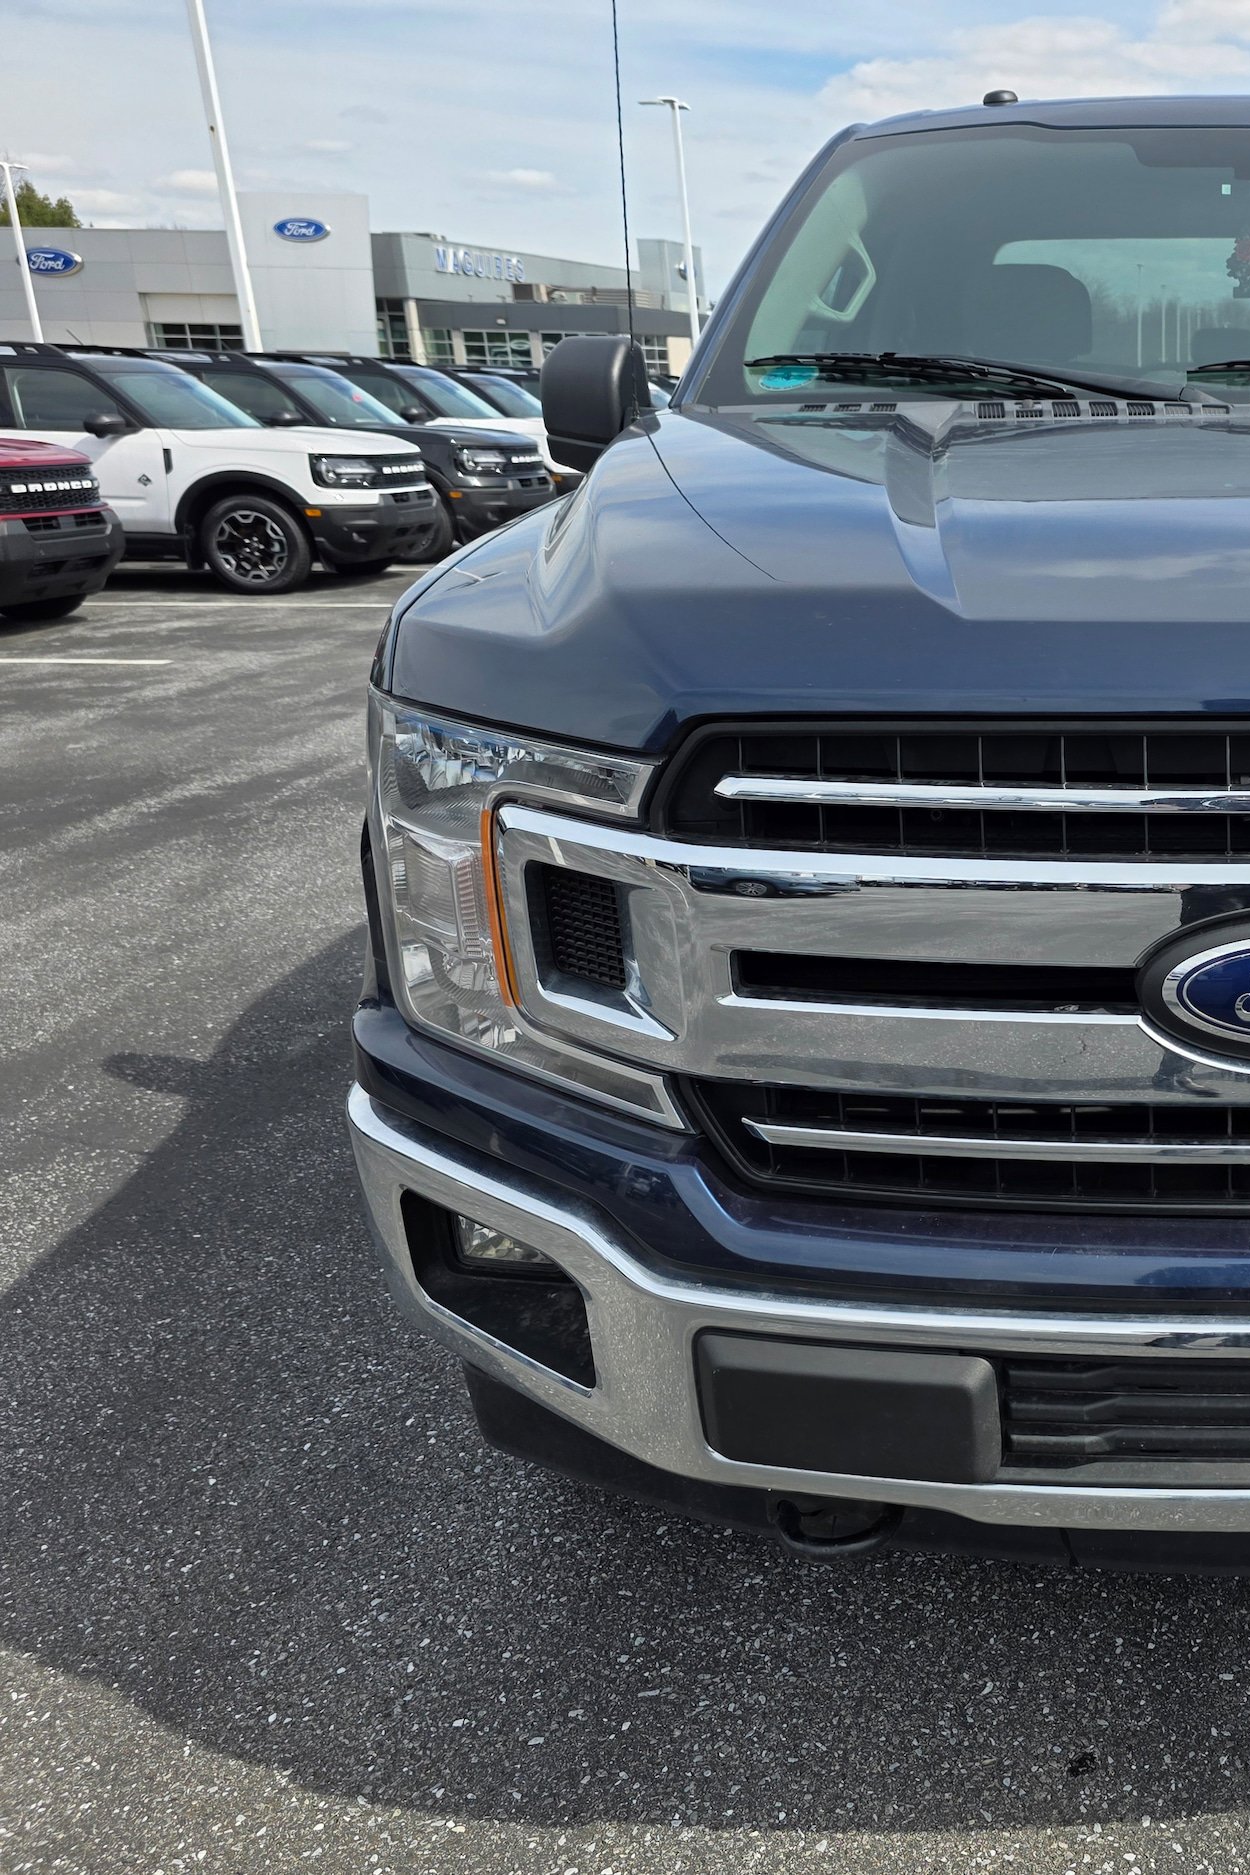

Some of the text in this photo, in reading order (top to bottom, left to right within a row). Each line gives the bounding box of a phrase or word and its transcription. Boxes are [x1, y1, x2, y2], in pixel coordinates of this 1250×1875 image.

[283, 222, 316, 236] Ford
[29, 253, 65, 270] Ford
[435, 247, 526, 282] MAGUIRES
[10, 480, 93, 494] BRONCO
